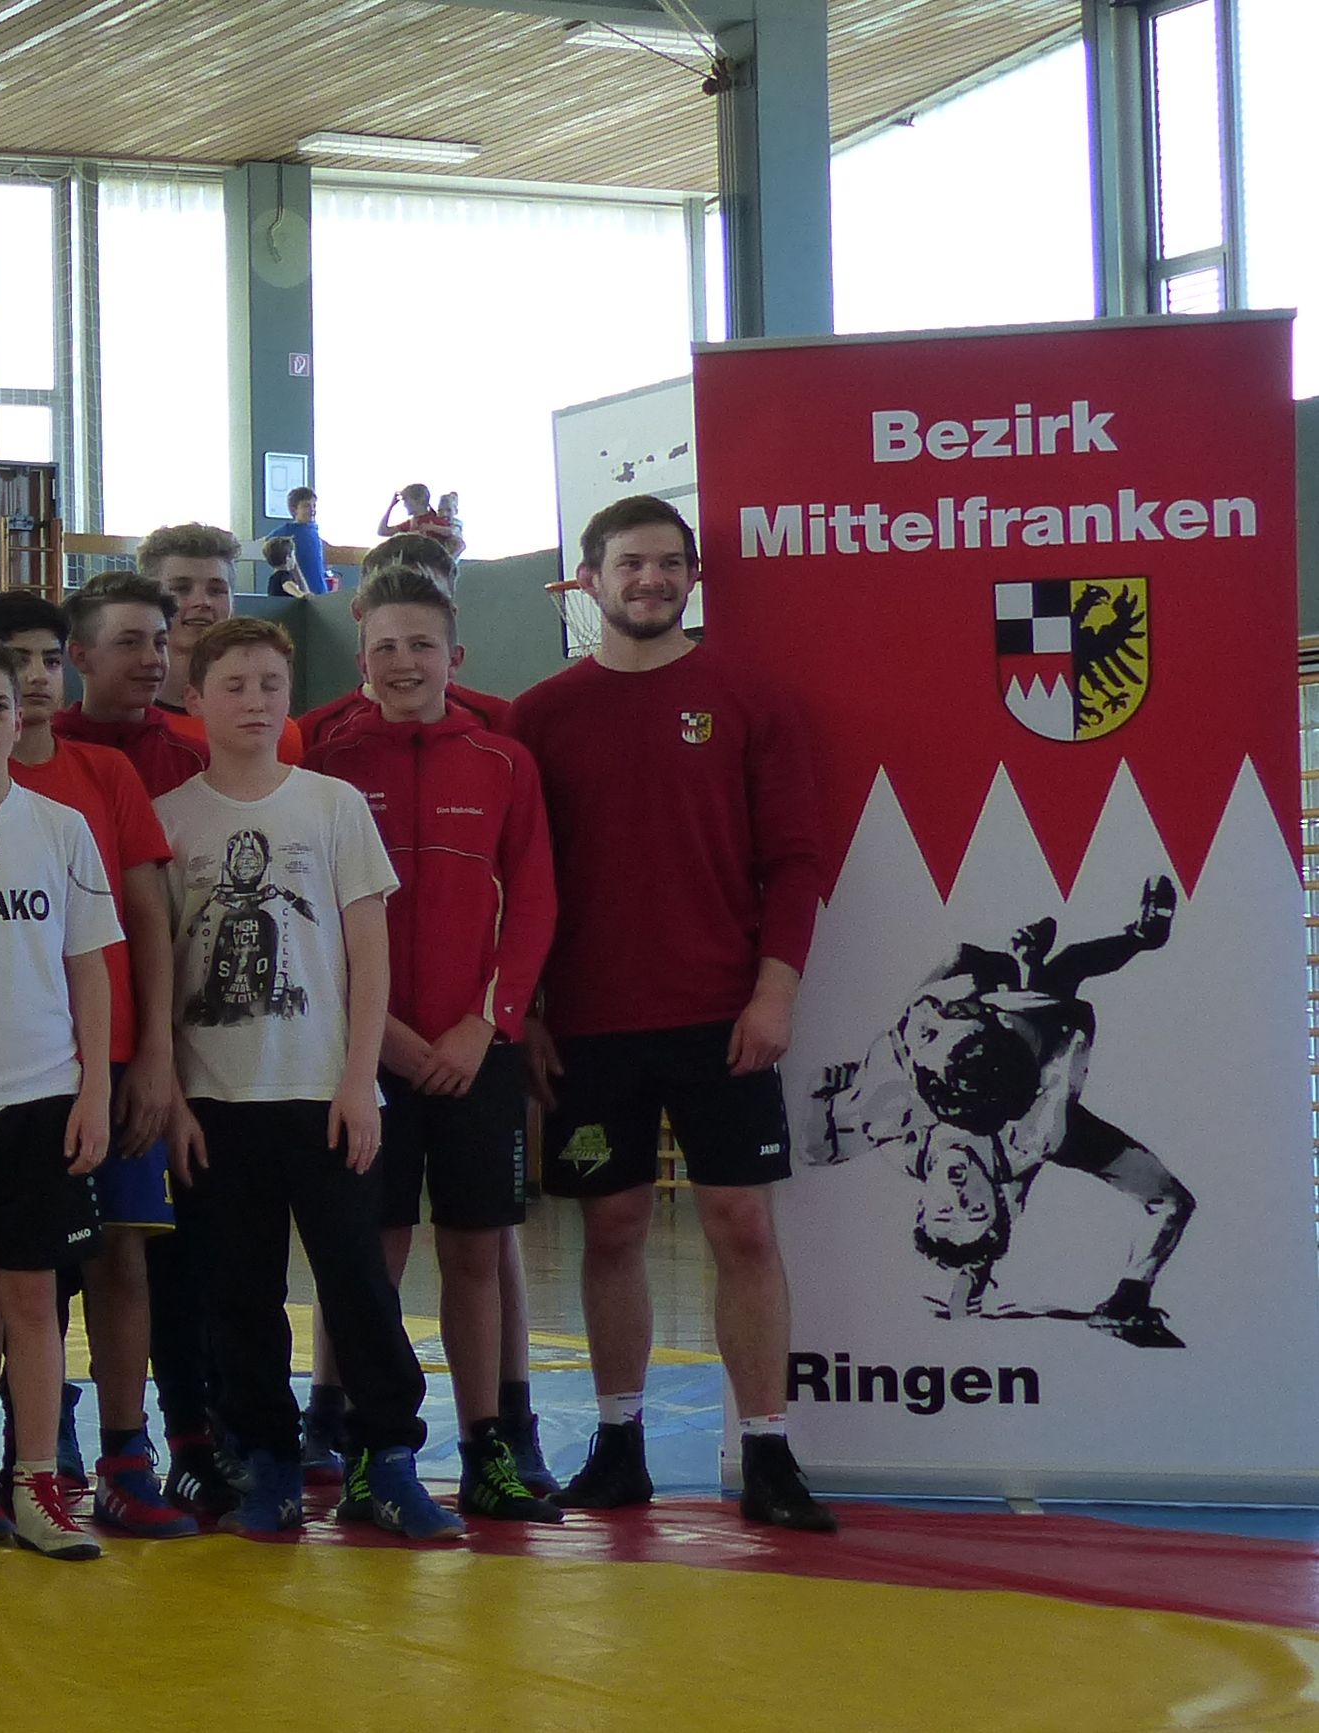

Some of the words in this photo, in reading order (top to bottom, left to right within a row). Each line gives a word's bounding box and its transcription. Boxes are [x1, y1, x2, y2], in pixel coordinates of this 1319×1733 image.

[872, 400, 1119, 463] Bezirk
[740, 488, 1257, 559] Mittelfranken
[759, 1143, 781, 1156] JAKO
[67, 1228, 92, 1244] JAKO
[786, 1351, 1040, 1415] Ringen
